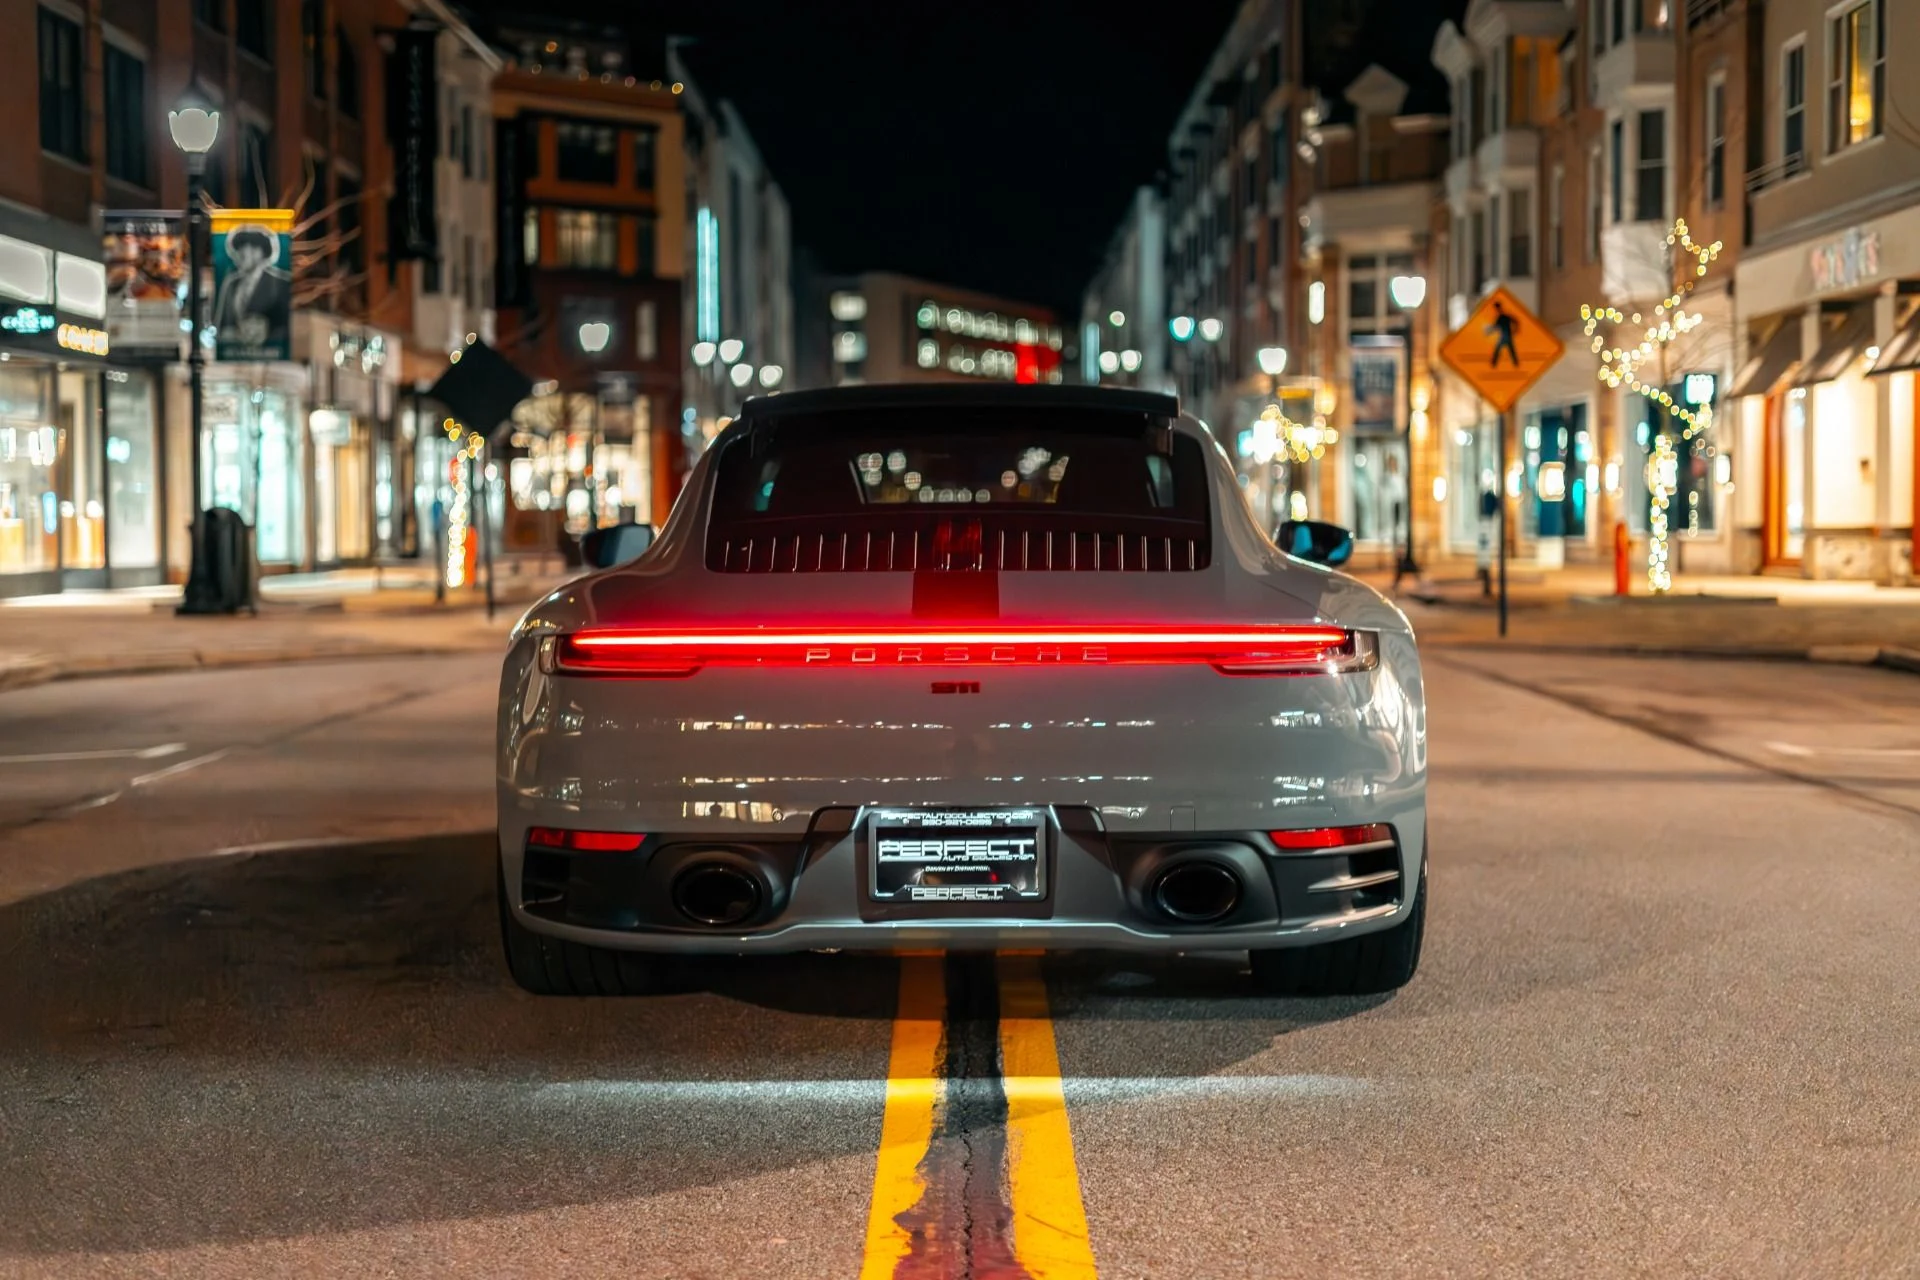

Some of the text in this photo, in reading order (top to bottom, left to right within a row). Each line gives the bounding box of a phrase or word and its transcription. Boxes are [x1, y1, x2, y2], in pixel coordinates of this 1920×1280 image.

[805, 646, 1109, 663] PORSCHE
[931, 682, 980, 694] 911
[878, 839, 1035, 862] PERFECT
[911, 887, 1004, 900] PERFECT
